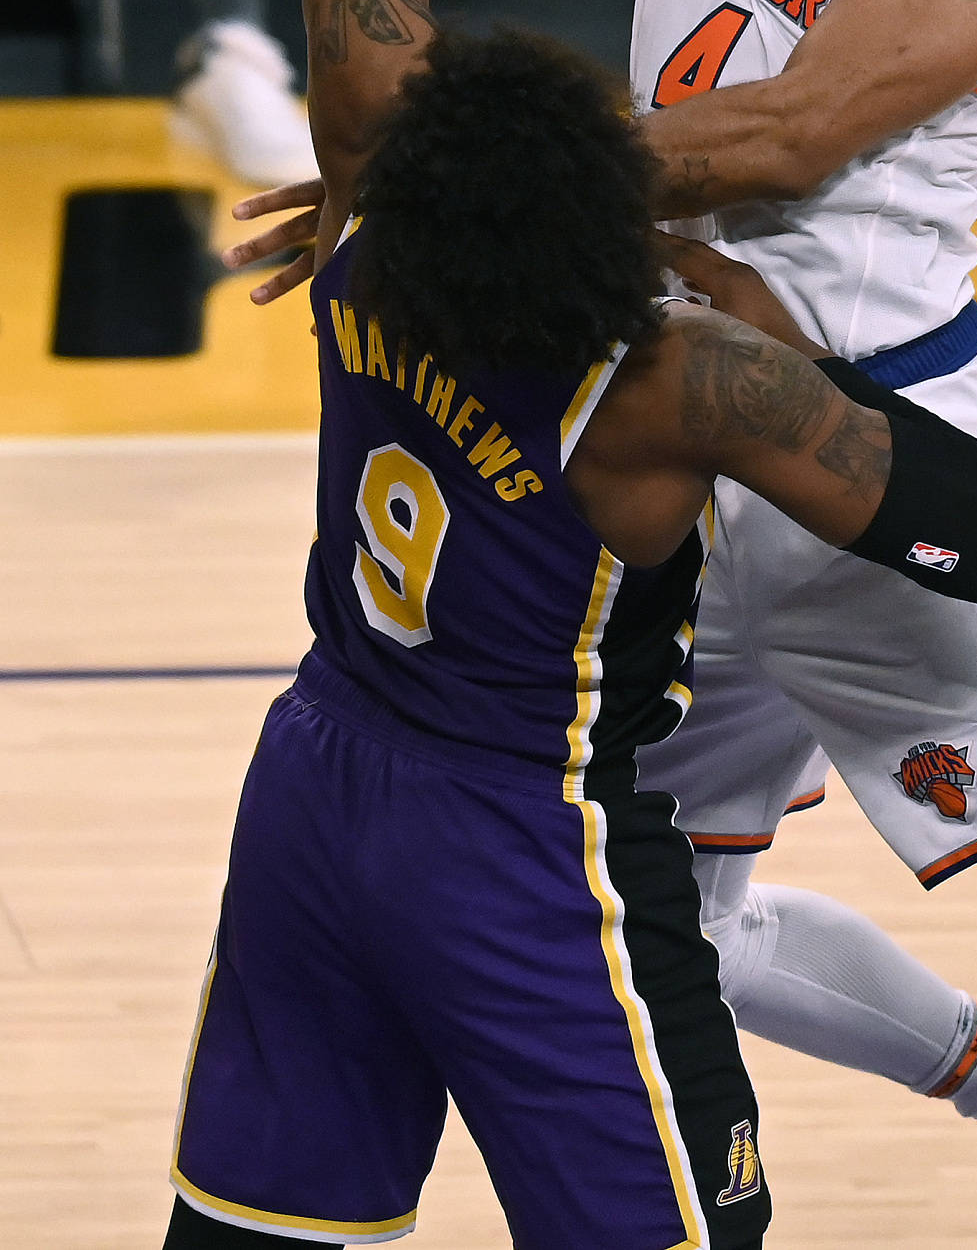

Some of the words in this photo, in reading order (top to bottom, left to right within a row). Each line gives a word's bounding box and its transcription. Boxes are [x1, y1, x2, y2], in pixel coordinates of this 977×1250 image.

[651, 2, 754, 110] 4
[352, 442, 451, 648] 9
[900, 744, 975, 798] KNICKS
